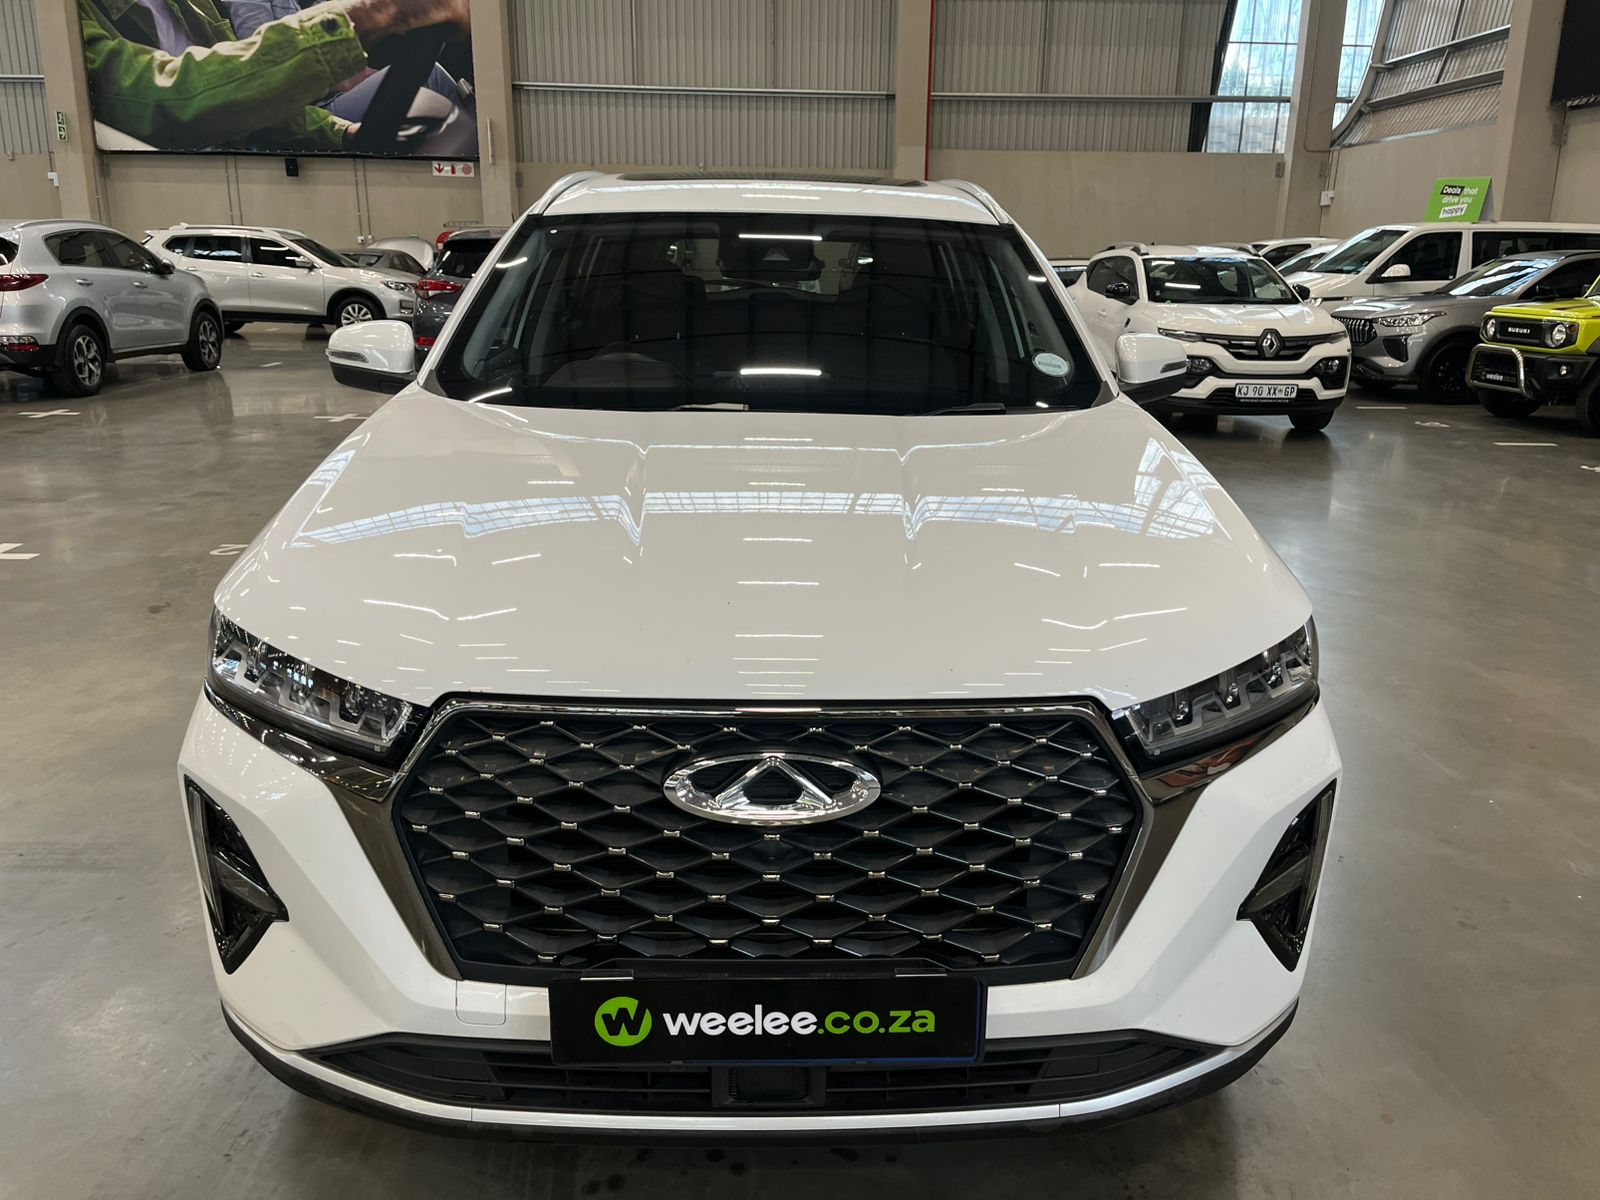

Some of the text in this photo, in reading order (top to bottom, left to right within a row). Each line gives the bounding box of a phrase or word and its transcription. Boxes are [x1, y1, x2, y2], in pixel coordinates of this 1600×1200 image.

[1442, 186, 1478, 195] Deals that
[1442, 195, 1473, 205] drive you
[1442, 206, 1465, 215] happy
[1237, 385, 1295, 397] KJ 90 XX GP
[662, 1004, 936, 1036] weelee.co.za
